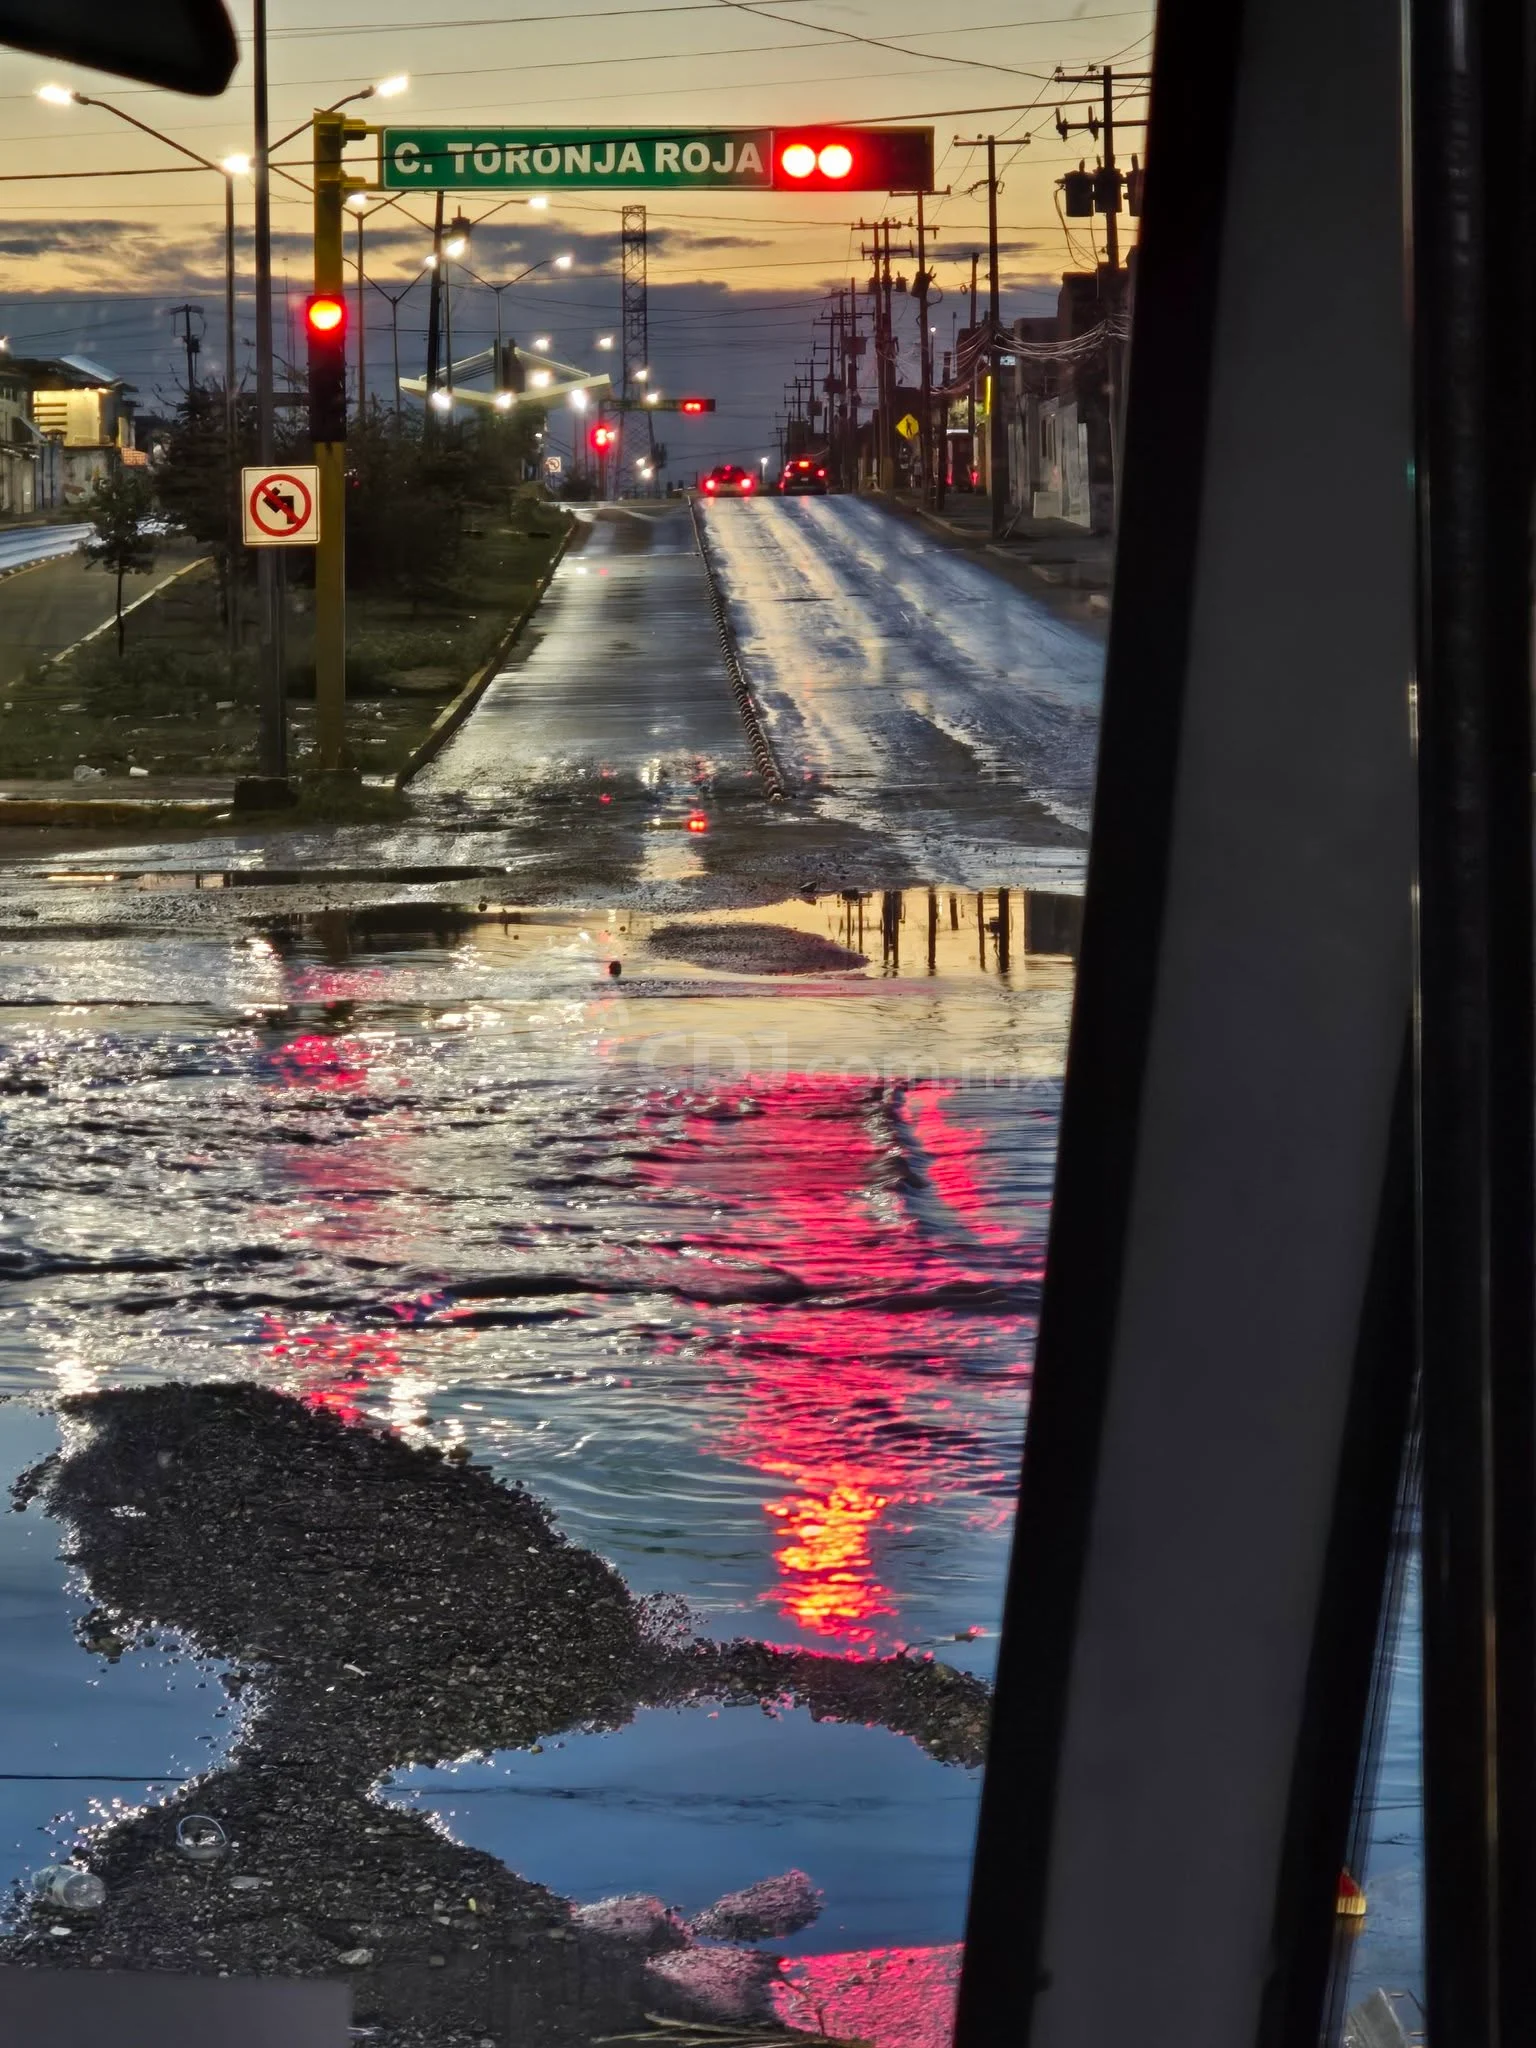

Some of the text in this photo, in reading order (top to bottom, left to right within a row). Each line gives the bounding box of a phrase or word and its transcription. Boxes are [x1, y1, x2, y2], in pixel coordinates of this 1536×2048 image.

[394, 142, 764, 174] C. TORONJA ROJA
